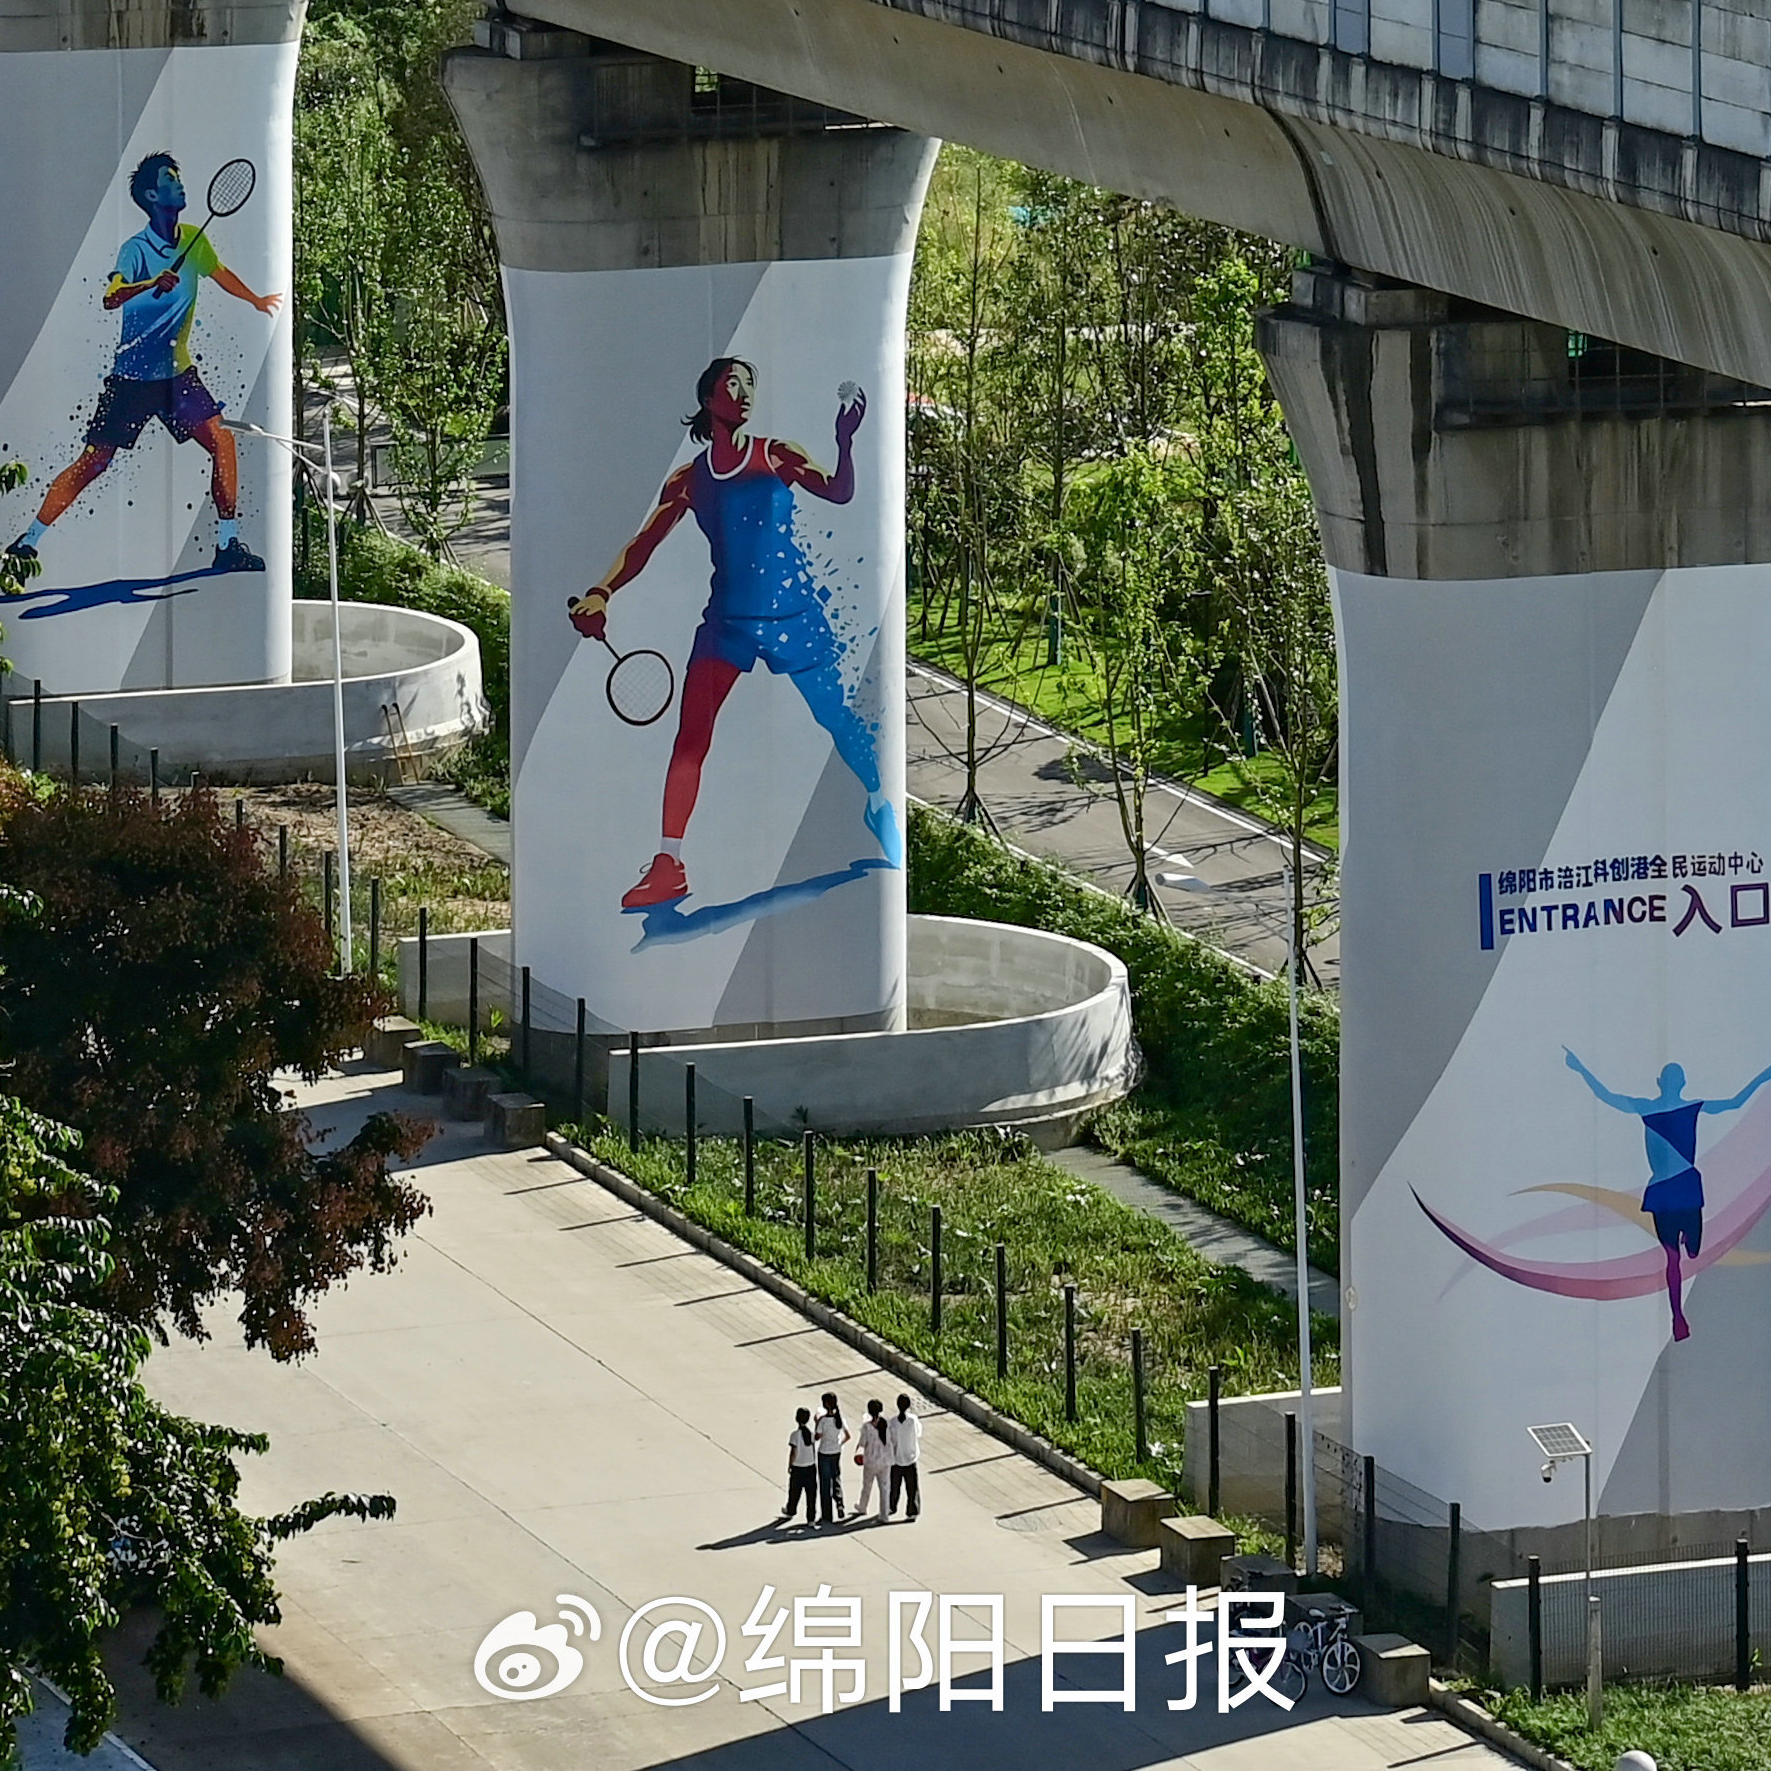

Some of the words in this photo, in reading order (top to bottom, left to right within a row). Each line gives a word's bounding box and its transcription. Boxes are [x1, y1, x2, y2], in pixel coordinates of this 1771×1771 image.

[1498, 851, 1764, 895] 绵阳市涪江科创港全民运动中心
[1498, 894, 1667, 935] ENTRANCE
[1672, 882, 1770, 937] 入口
